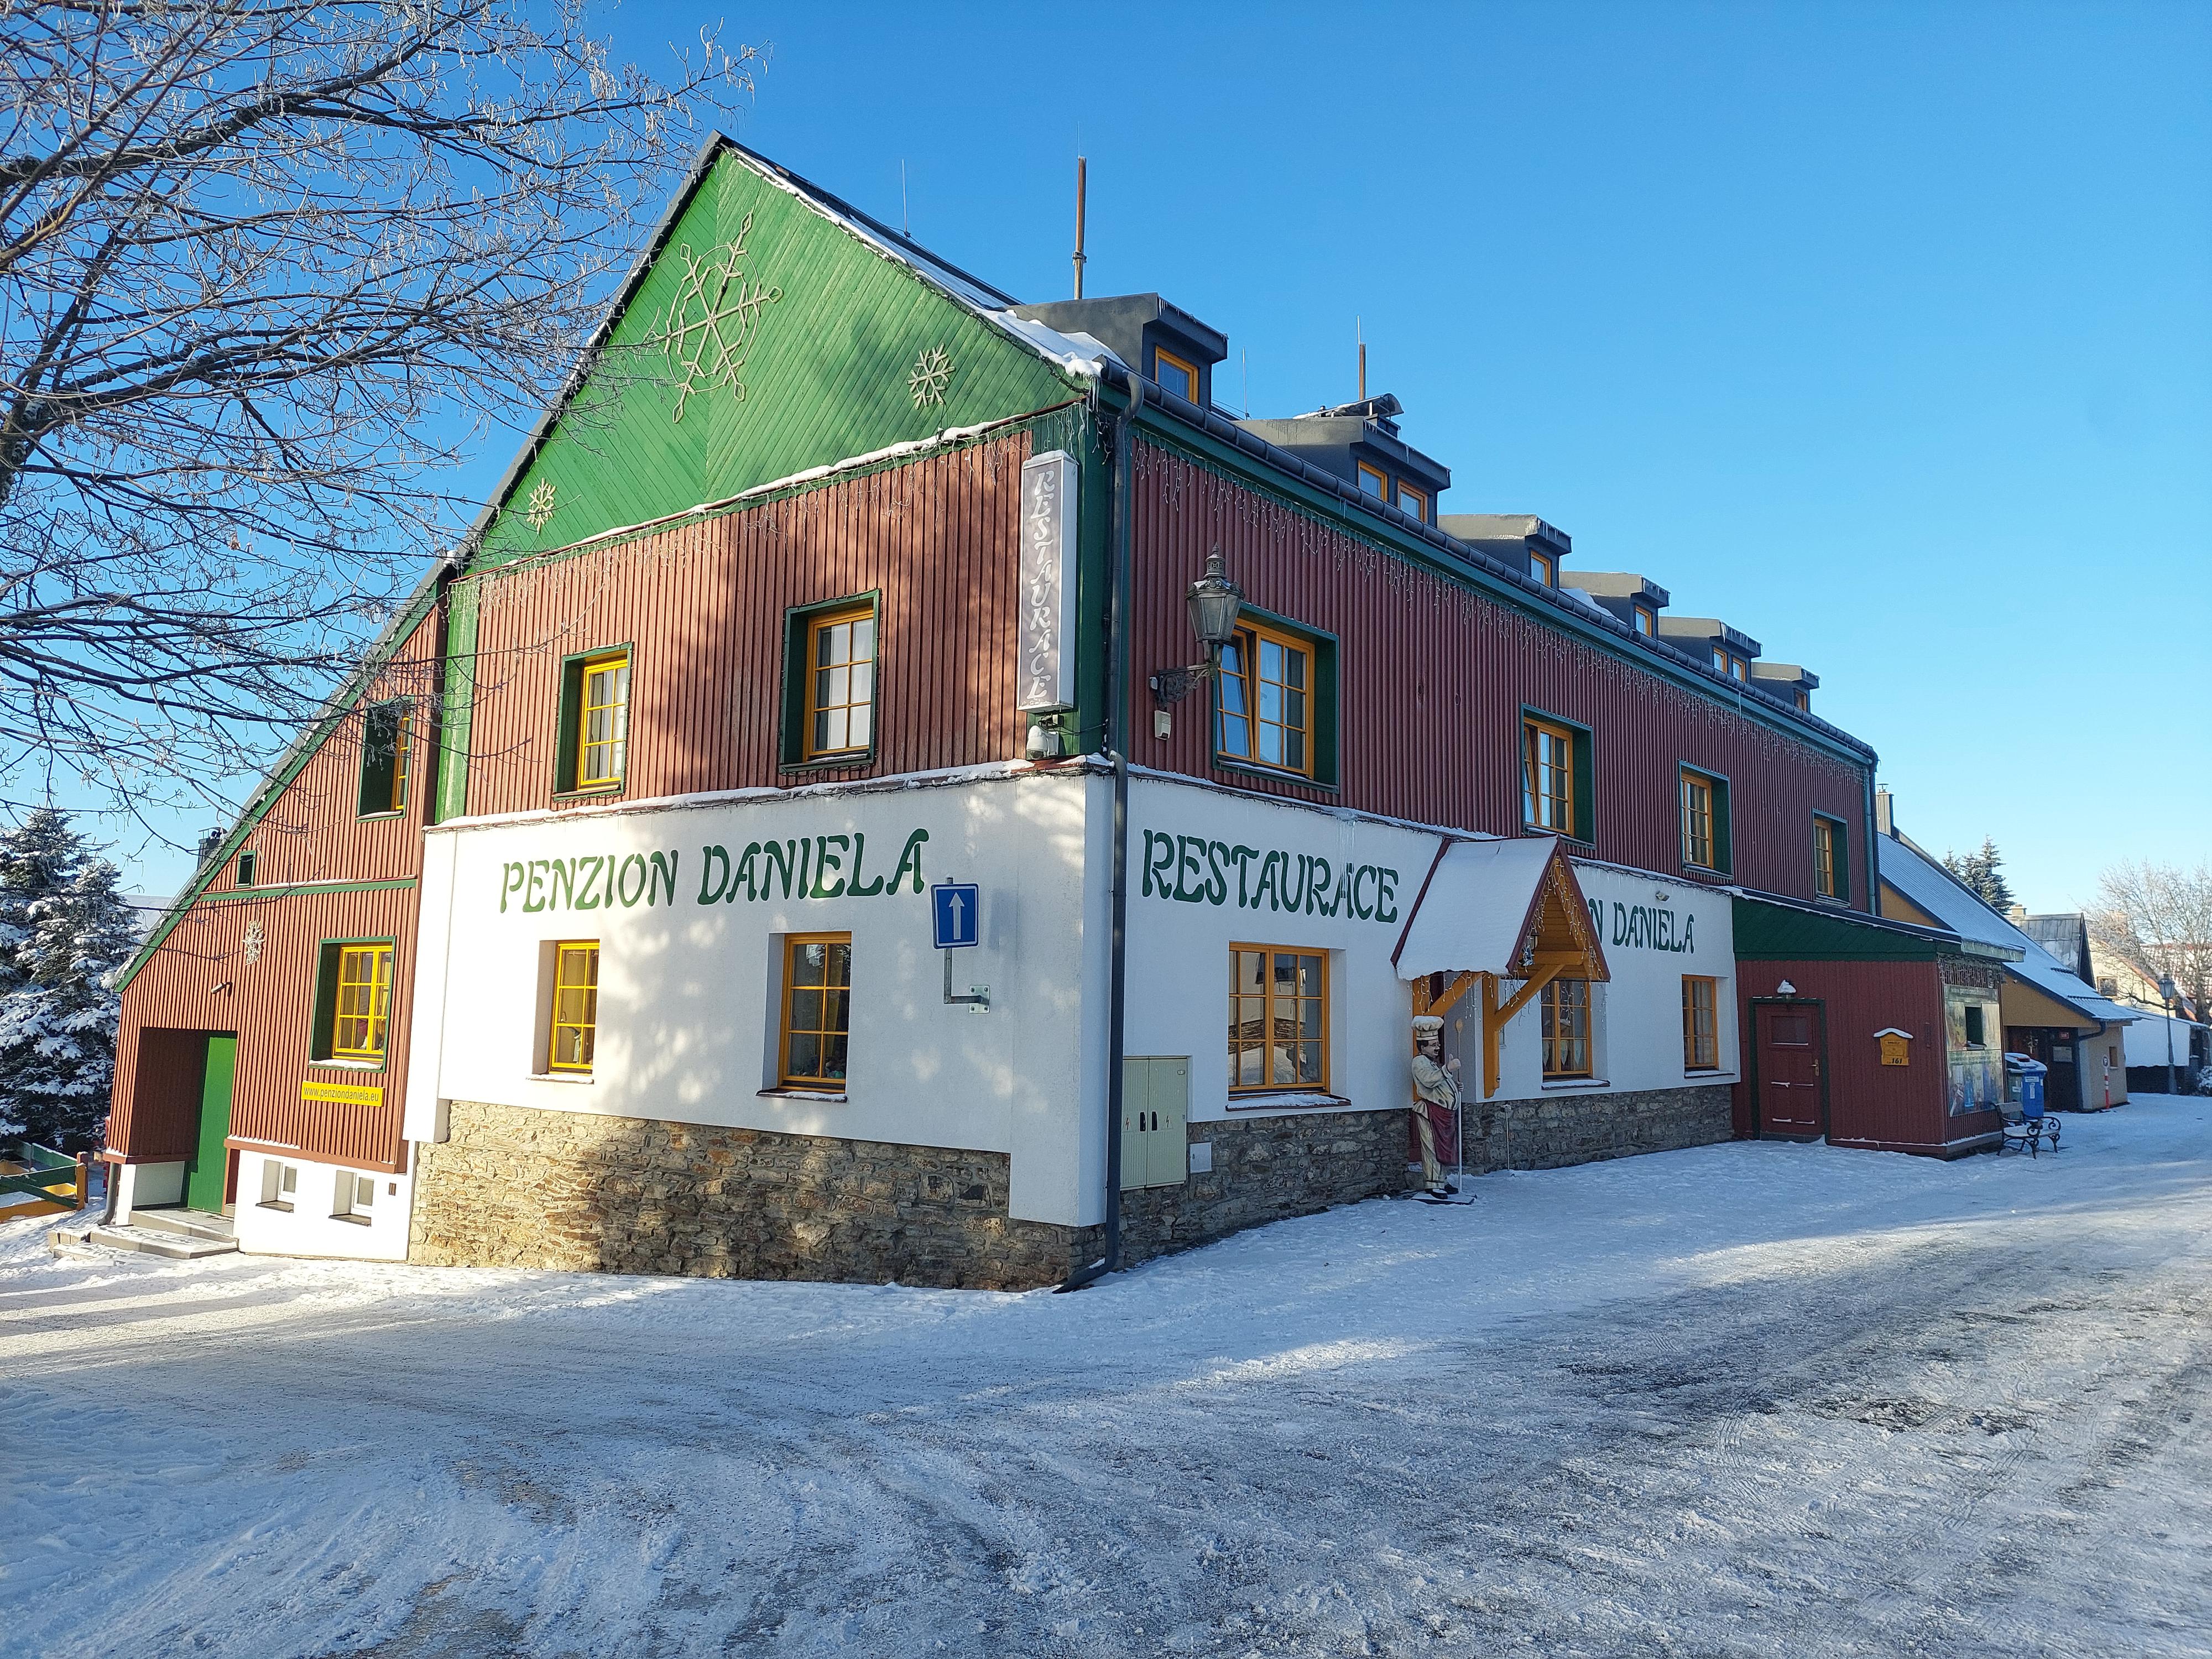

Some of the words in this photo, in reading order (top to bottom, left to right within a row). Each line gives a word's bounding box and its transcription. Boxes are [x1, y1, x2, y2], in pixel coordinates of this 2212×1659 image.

[1026, 469, 1056, 700] RESTAURACE
[499, 848, 680, 914] PENZION
[696, 828, 930, 906] DANIELA
[1141, 828, 1399, 924] RESTAURACE
[1612, 901, 1694, 954] DANIELA
[304, 1087, 379, 1102] www.penziondaniela.eu
